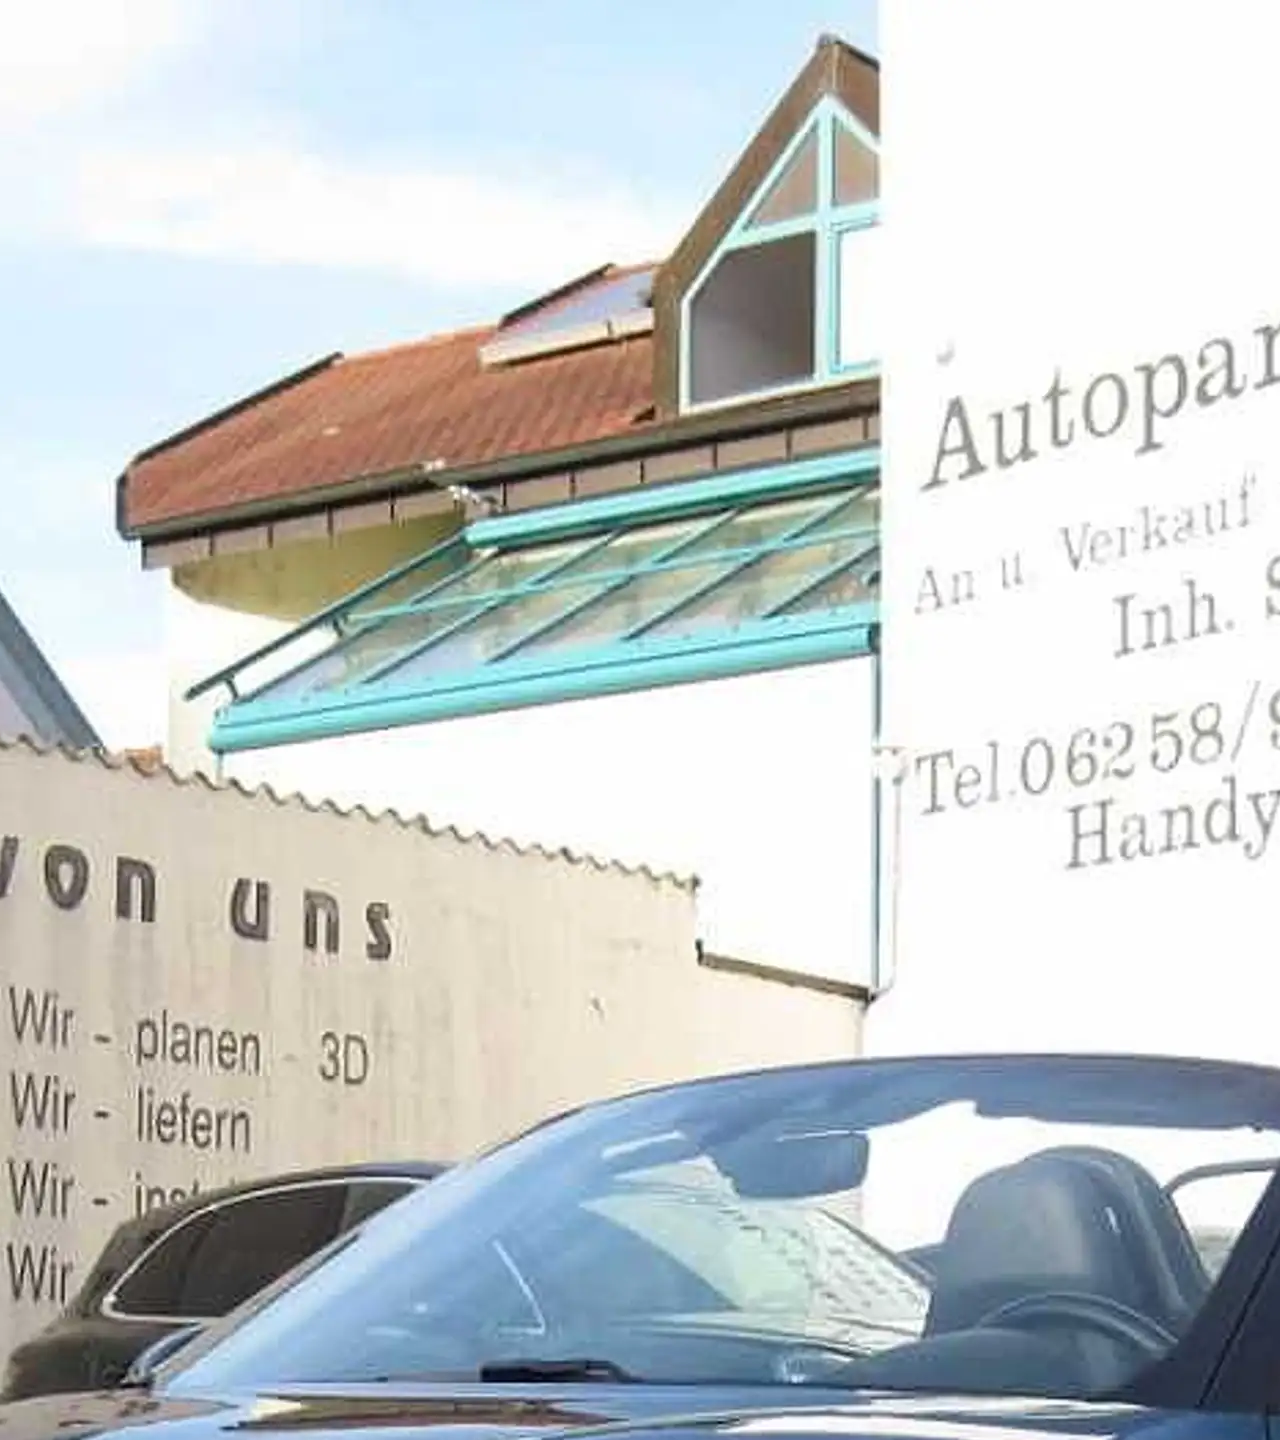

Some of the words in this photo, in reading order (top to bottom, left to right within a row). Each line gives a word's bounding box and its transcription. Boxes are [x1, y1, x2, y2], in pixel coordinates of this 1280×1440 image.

[1060, 474, 1257, 571] Verkauf
[1113, 580, 1234, 657] Inh.
[230, 878, 394, 961] uns
[9, 987, 74, 1048] Wir
[136, 1010, 261, 1076] planen
[320, 1030, 369, 1085] 3D
[9, 1073, 76, 1137] Wir
[136, 1089, 252, 1153] liefern
[8, 1158, 74, 1219] Wir
[7, 1243, 73, 1303] Wir
